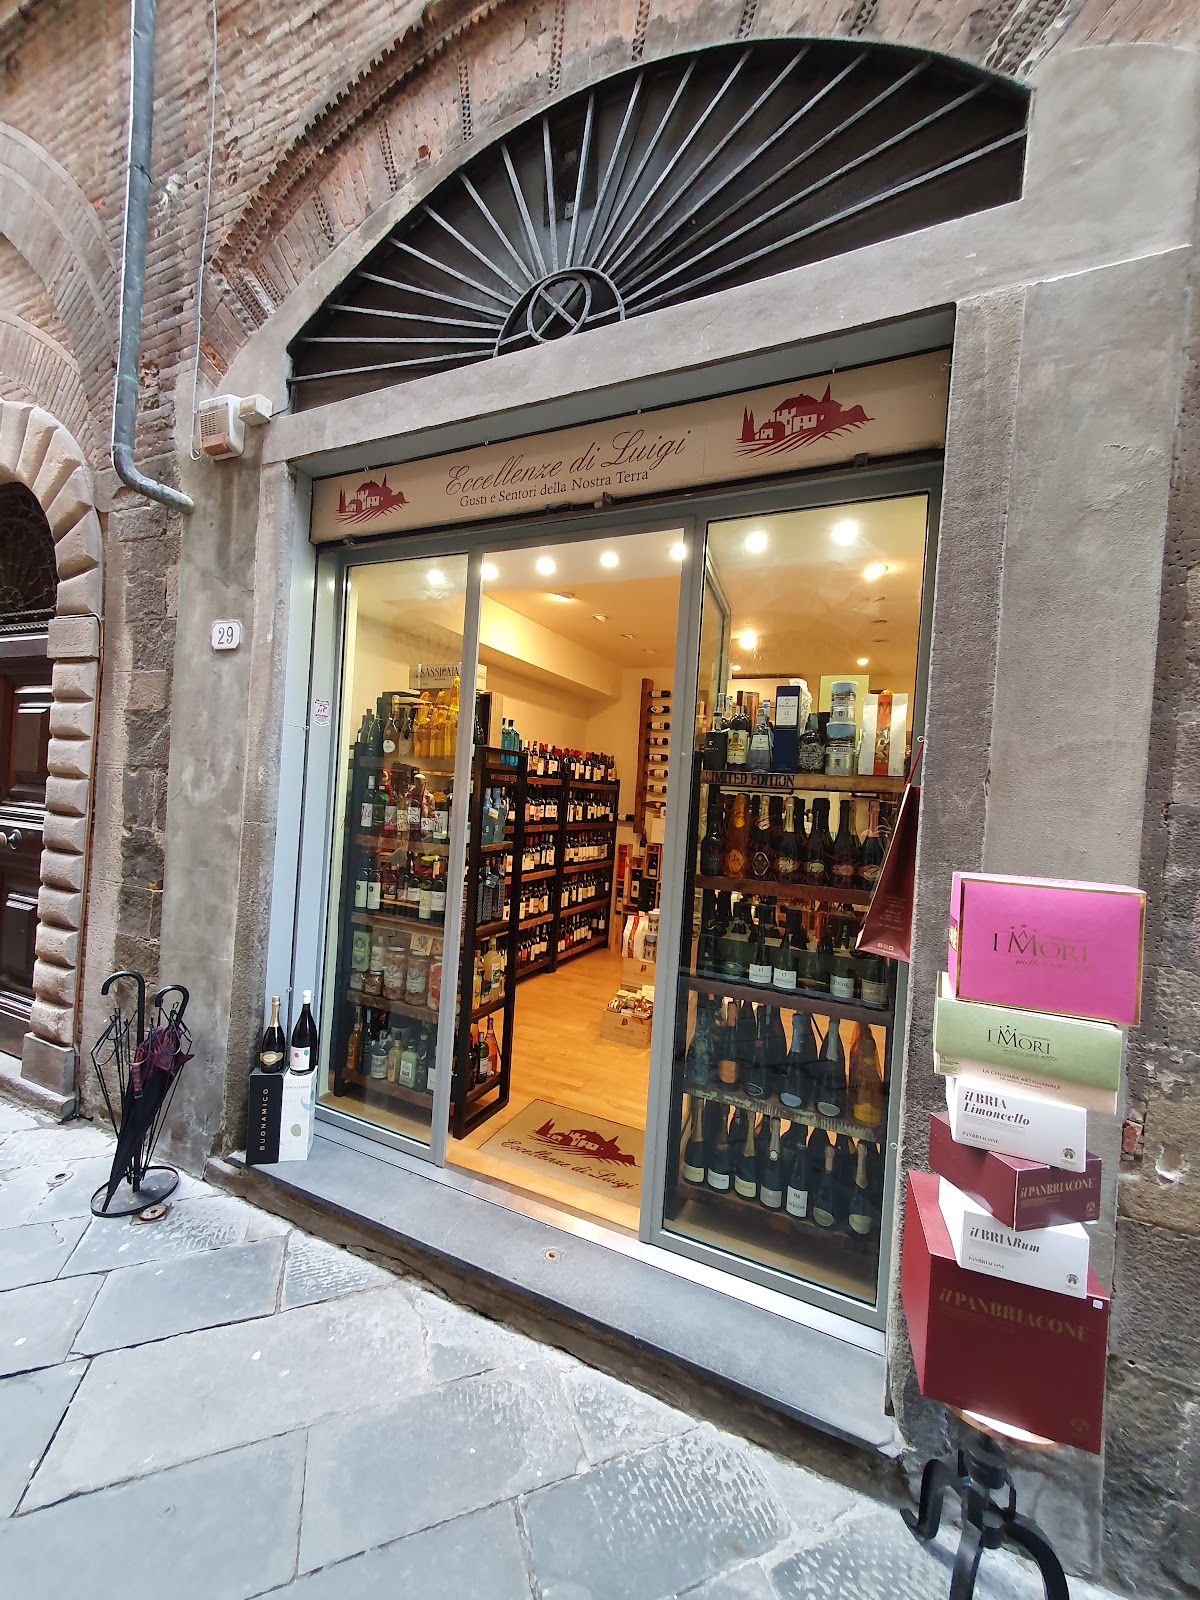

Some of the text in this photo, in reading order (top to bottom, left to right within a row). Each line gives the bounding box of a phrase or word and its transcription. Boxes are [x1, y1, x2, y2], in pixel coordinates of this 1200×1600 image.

[446, 429, 692, 495] Eccellenze di Luigi
[460, 470, 649, 507] Gusti e Sentori della Nostra Terra
[217, 626, 234, 645] 29
[750, 773, 795, 787] EDITION
[993, 925, 1088, 962] I MORI
[987, 1029, 991, 1042] I
[997, 1026, 1051, 1054] MORI
[991, 1070, 1019, 1080] COLOMBA
[1021, 1076, 1061, 1089] ARTIGIANALE
[259, 1089, 269, 1151] BUONAMICO
[964, 1102, 1030, 1125] Limoncello
[501, 1138, 639, 1190] Eccellenze di Luigi
